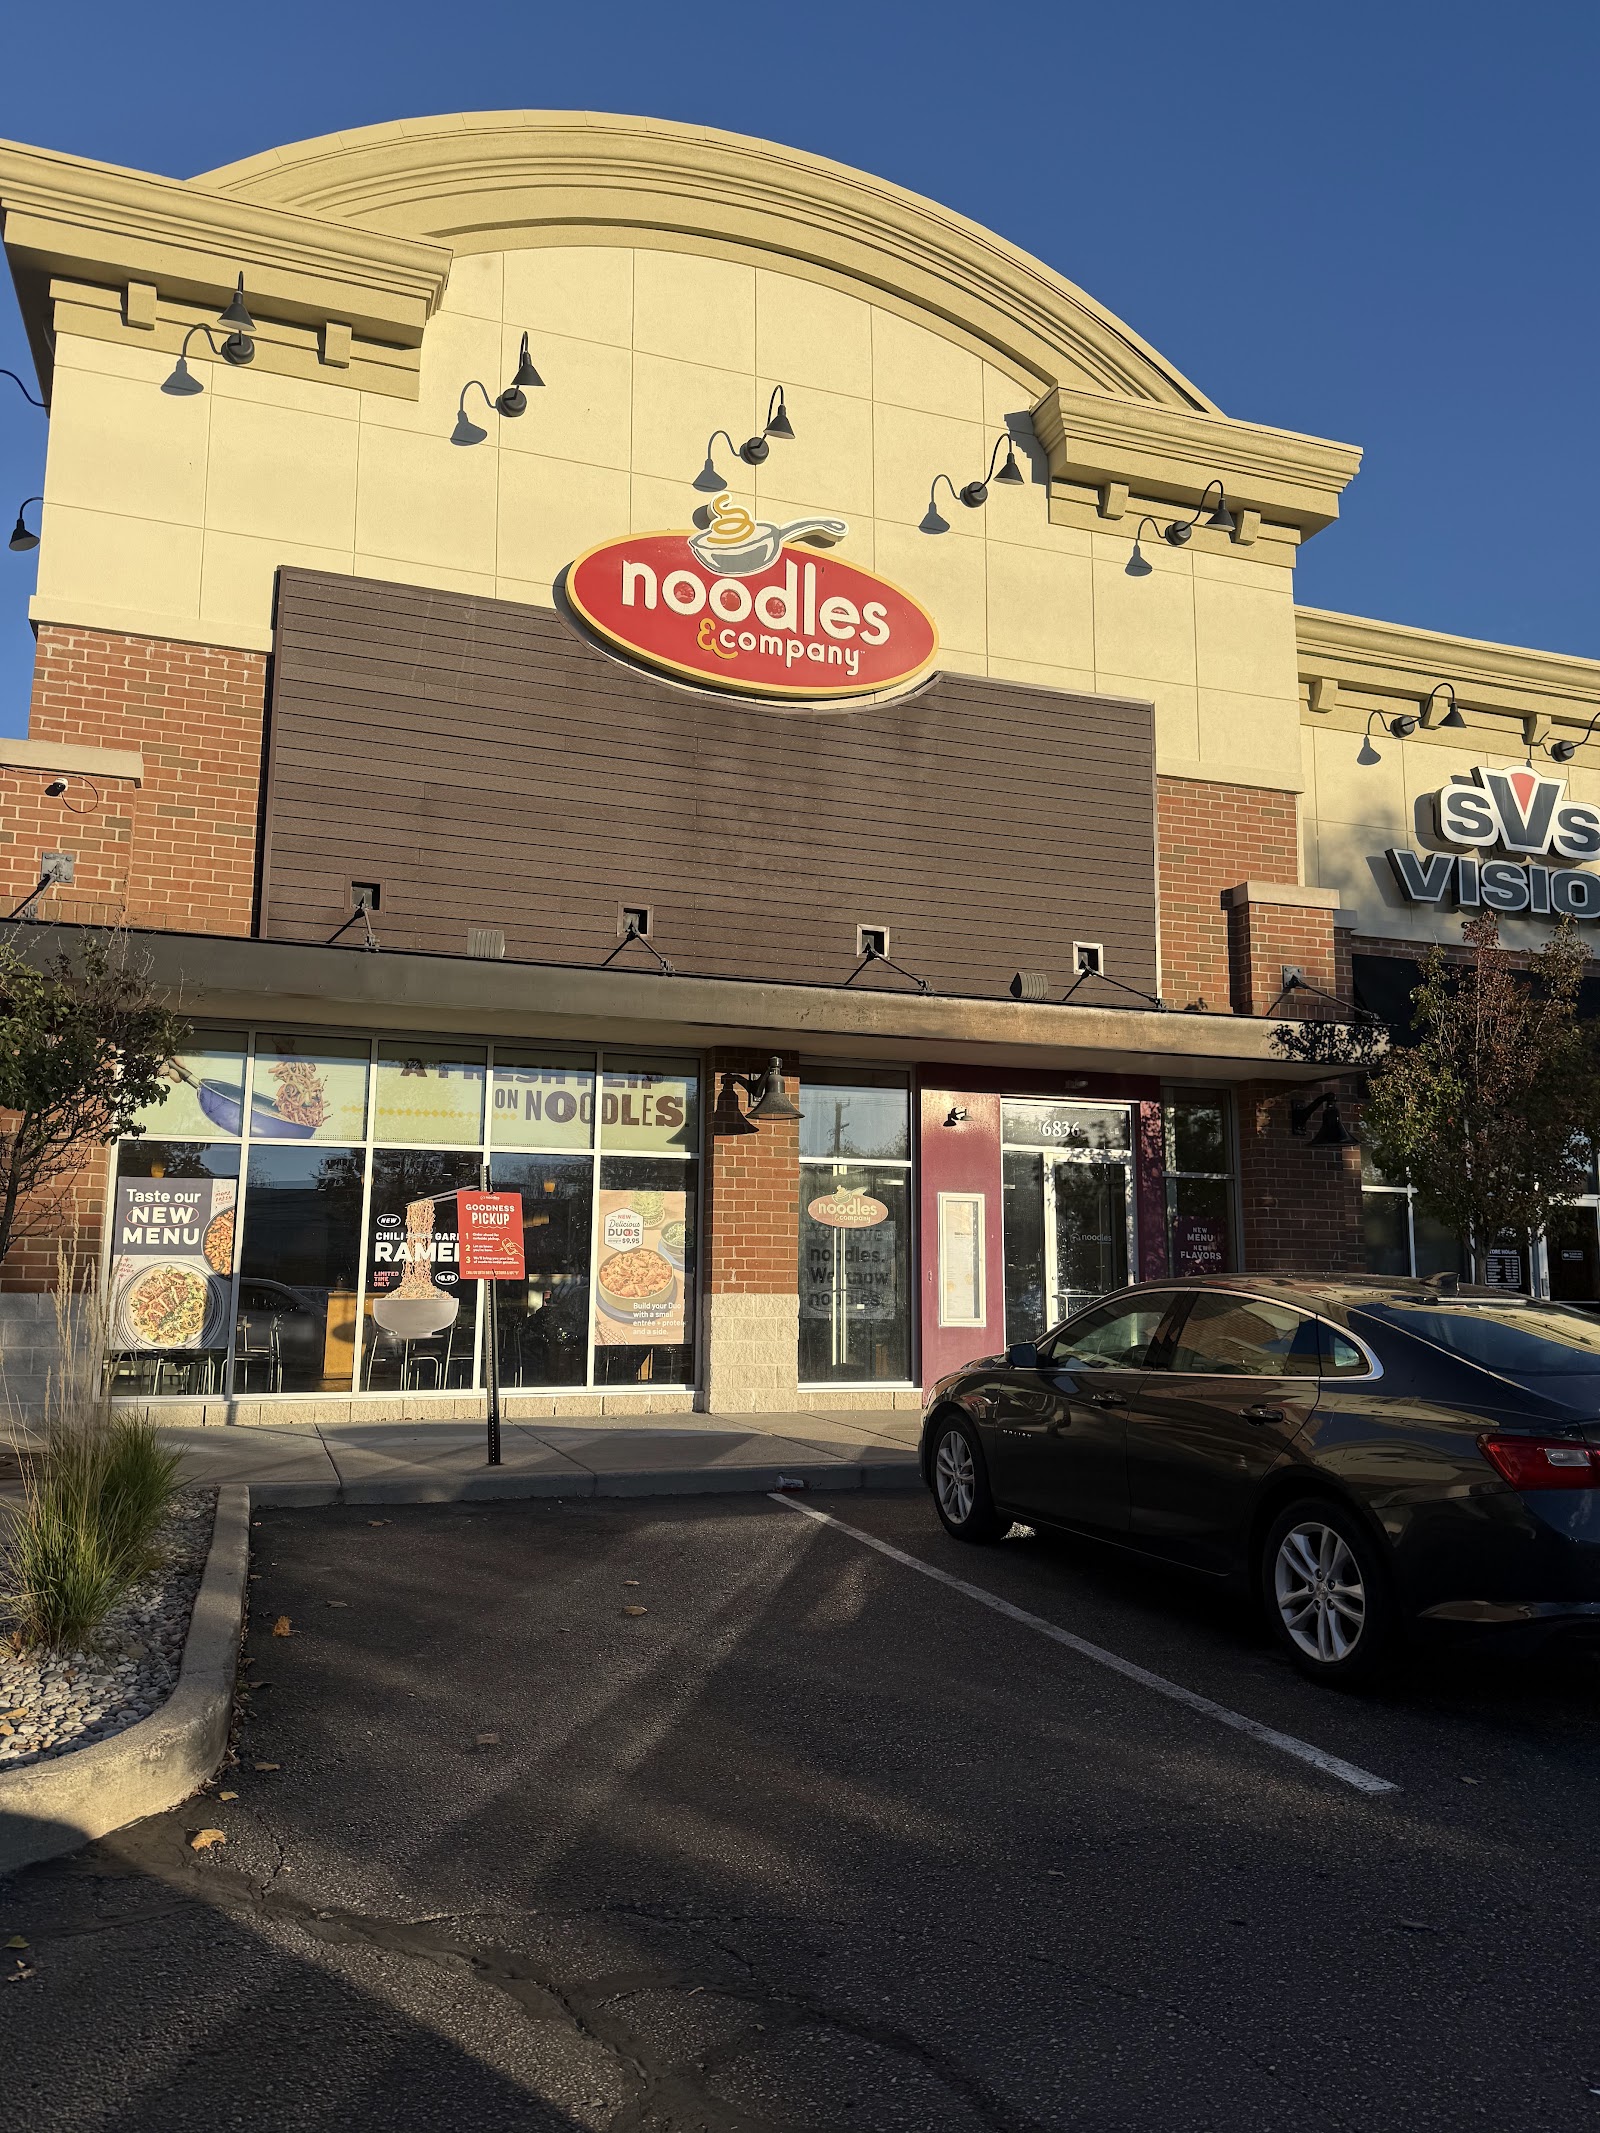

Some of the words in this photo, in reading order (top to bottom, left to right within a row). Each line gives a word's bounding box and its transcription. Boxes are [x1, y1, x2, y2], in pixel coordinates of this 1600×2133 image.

[621, 559, 891, 646] noodles
[400, 1058, 428, 1078] A
[439, 1060, 566, 1086] FRESH
[495, 1088, 519, 1110] ON
[1041, 1120, 1081, 1138] 6836
[126, 1188, 171, 1203] Taste
[174, 1192, 201, 1204] our
[465, 1204, 515, 1212] GOODNESS
[818, 1198, 878, 1216] noodles
[131, 1206, 194, 1224] NEW
[471, 1212, 510, 1225] PICKUP
[608, 1219, 640, 1228] Delicious
[122, 1227, 200, 1245] MENU
[375, 1232, 404, 1241] CHILI
[465, 1232, 469, 1240] 1
[1081, 1233, 1112, 1242] noodles
[1186, 1233, 1214, 1242] MENU
[465, 1256, 471, 1264] 3
[1180, 1251, 1222, 1260] FLAVORS
